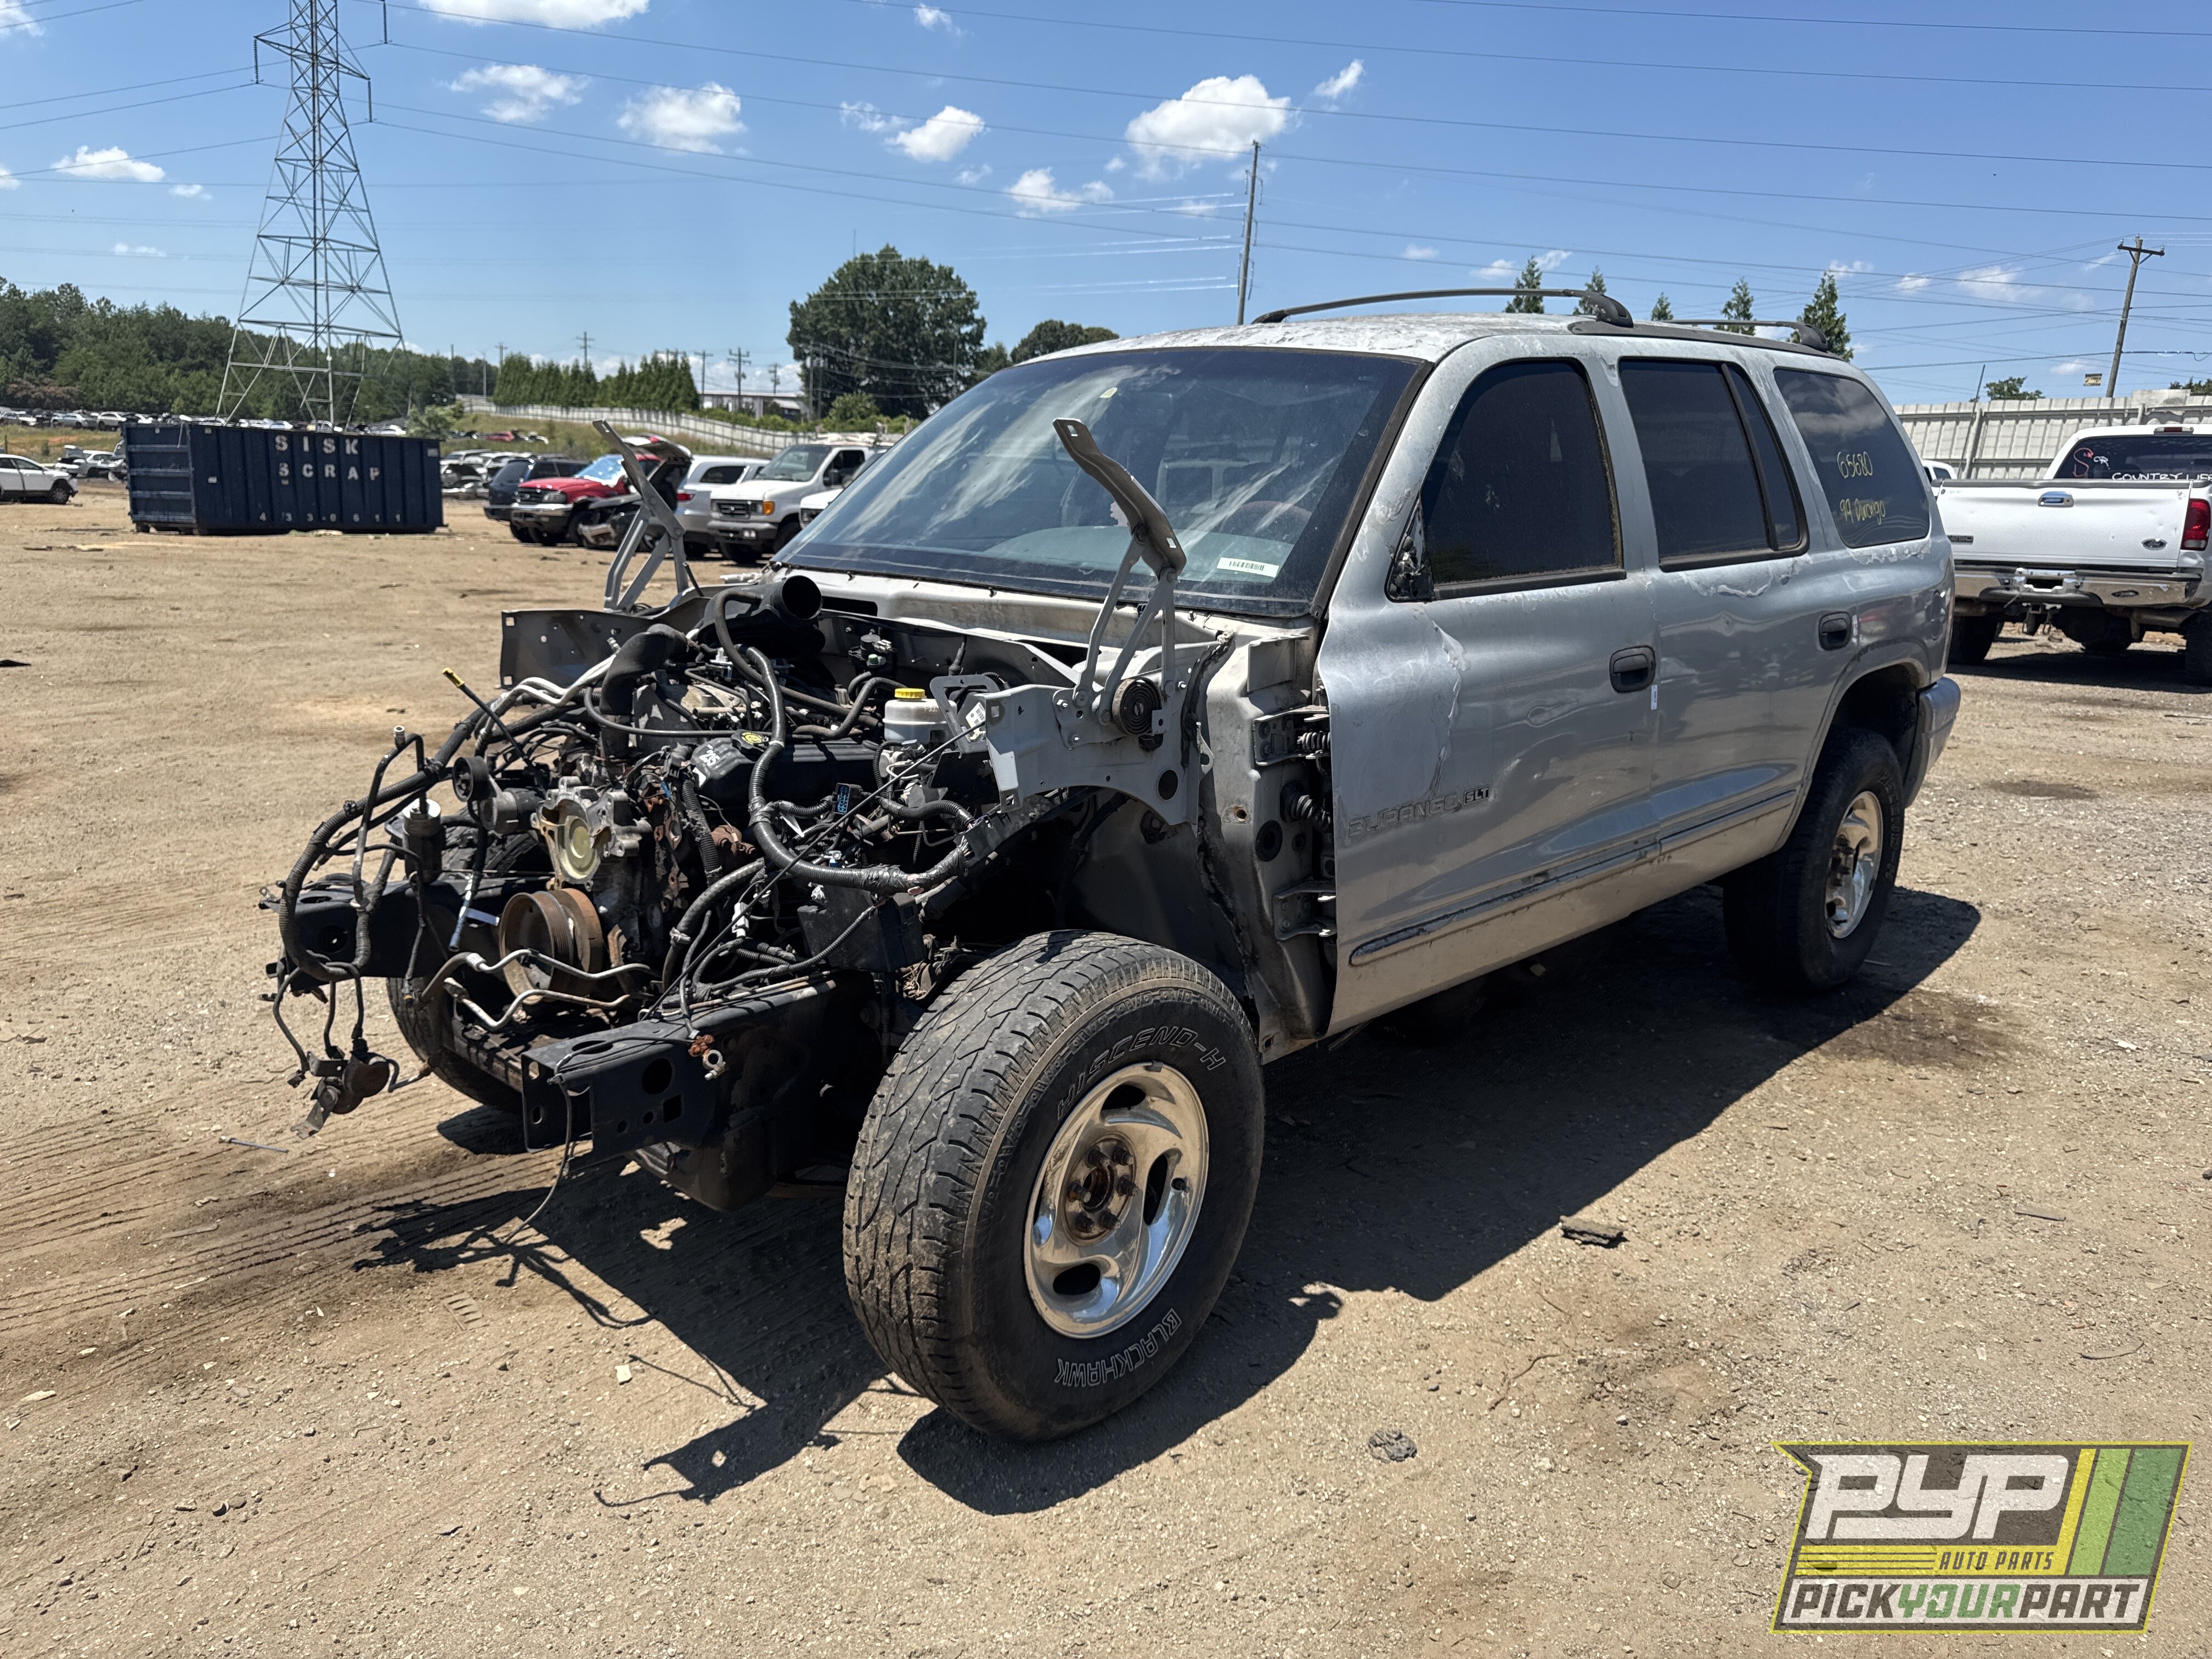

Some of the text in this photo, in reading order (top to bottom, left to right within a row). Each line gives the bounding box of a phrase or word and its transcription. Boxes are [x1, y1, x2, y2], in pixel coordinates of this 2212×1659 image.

[275, 435, 359, 455] SISK
[278, 462, 380, 481] SCRAP
[1837, 451, 1873, 479] 65680
[1348, 786, 1489, 837] DURANGO SLT
[1053, 1308, 1183, 1387] BLACKHAWK
